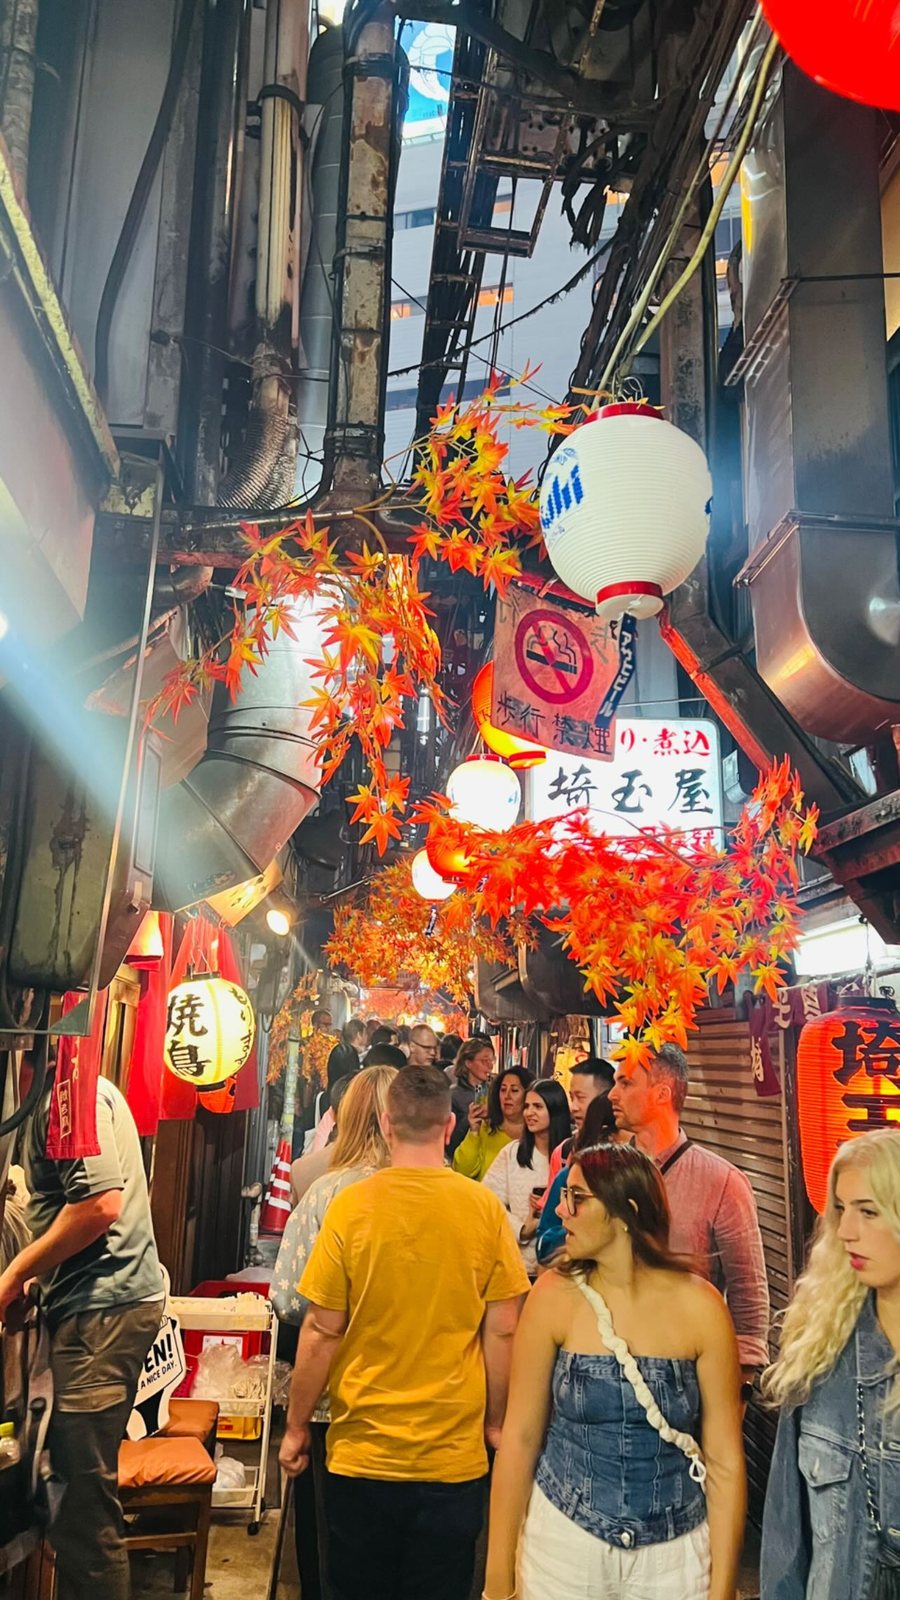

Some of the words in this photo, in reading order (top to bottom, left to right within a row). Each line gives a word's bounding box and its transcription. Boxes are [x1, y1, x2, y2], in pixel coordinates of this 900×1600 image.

[599, 631, 633, 717] アサヒビール
[547, 763, 713, 815] 埼玉屋
[166, 993, 211, 1077] 焼鳥
[147, 1369, 160, 1386] NICE
